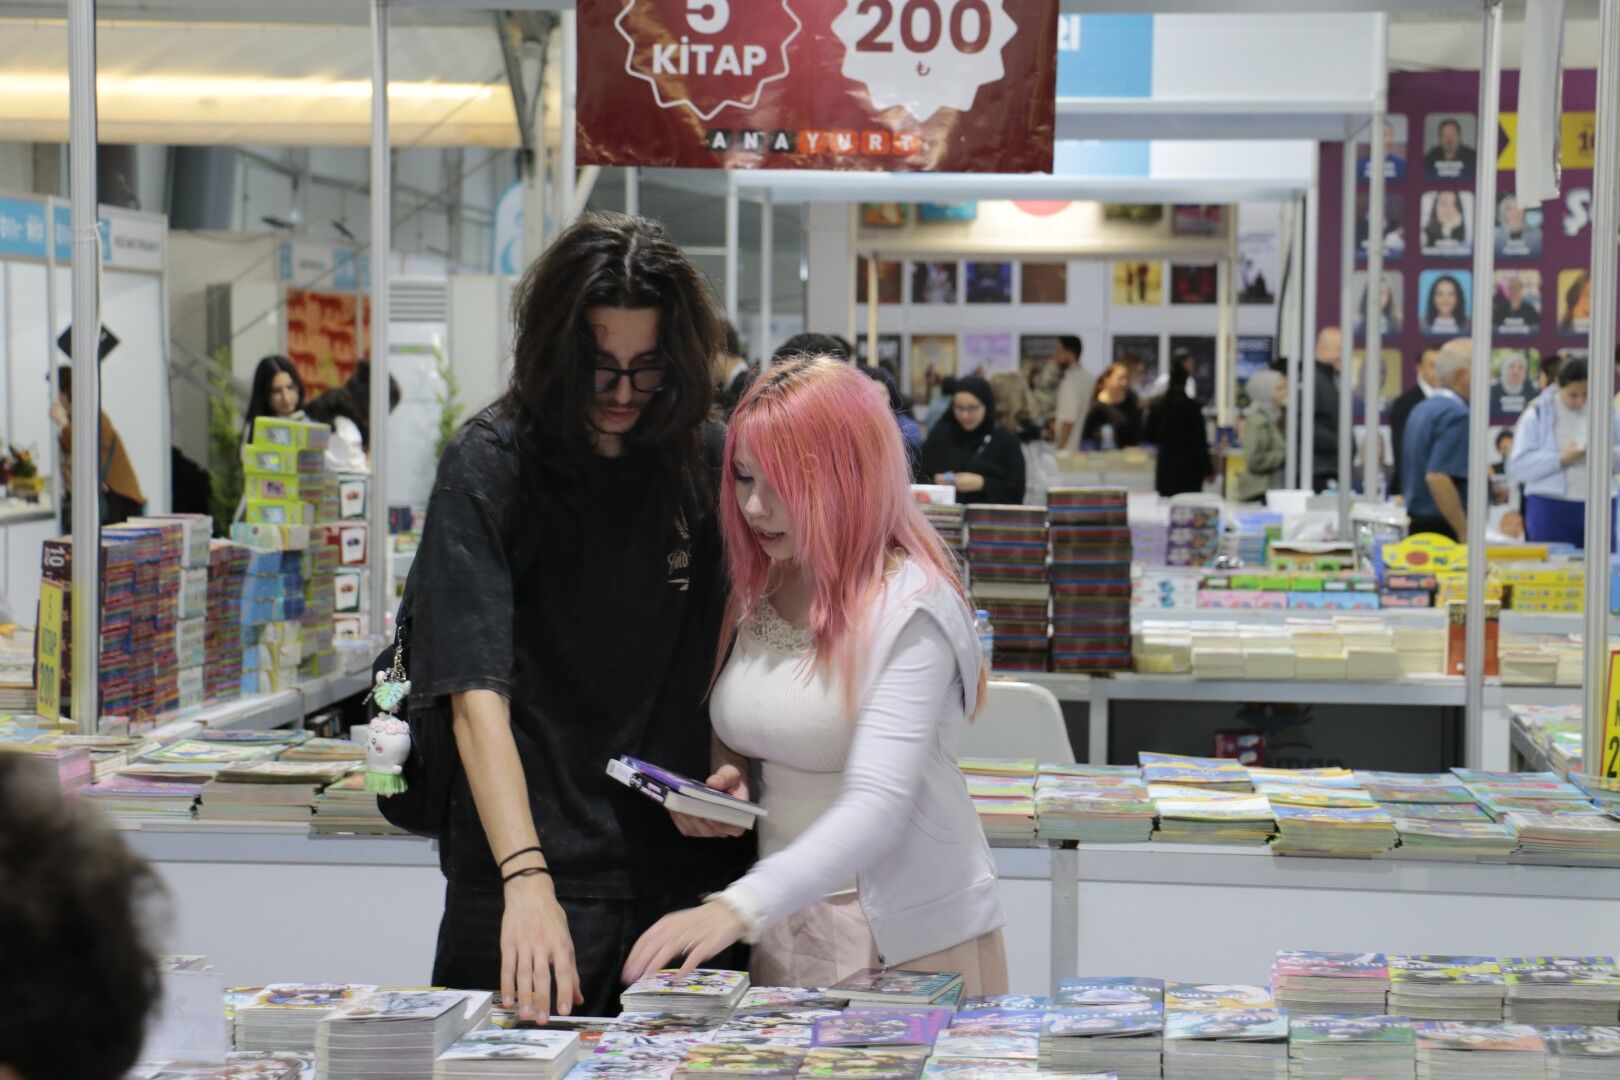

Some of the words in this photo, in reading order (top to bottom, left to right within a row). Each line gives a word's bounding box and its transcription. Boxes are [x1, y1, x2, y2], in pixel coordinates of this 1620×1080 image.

[686, 0, 730, 34] 5
[855, 0, 992, 54] 200
[652, 35, 767, 76] KİTAP
[711, 131, 914, 152] ANAYURT
